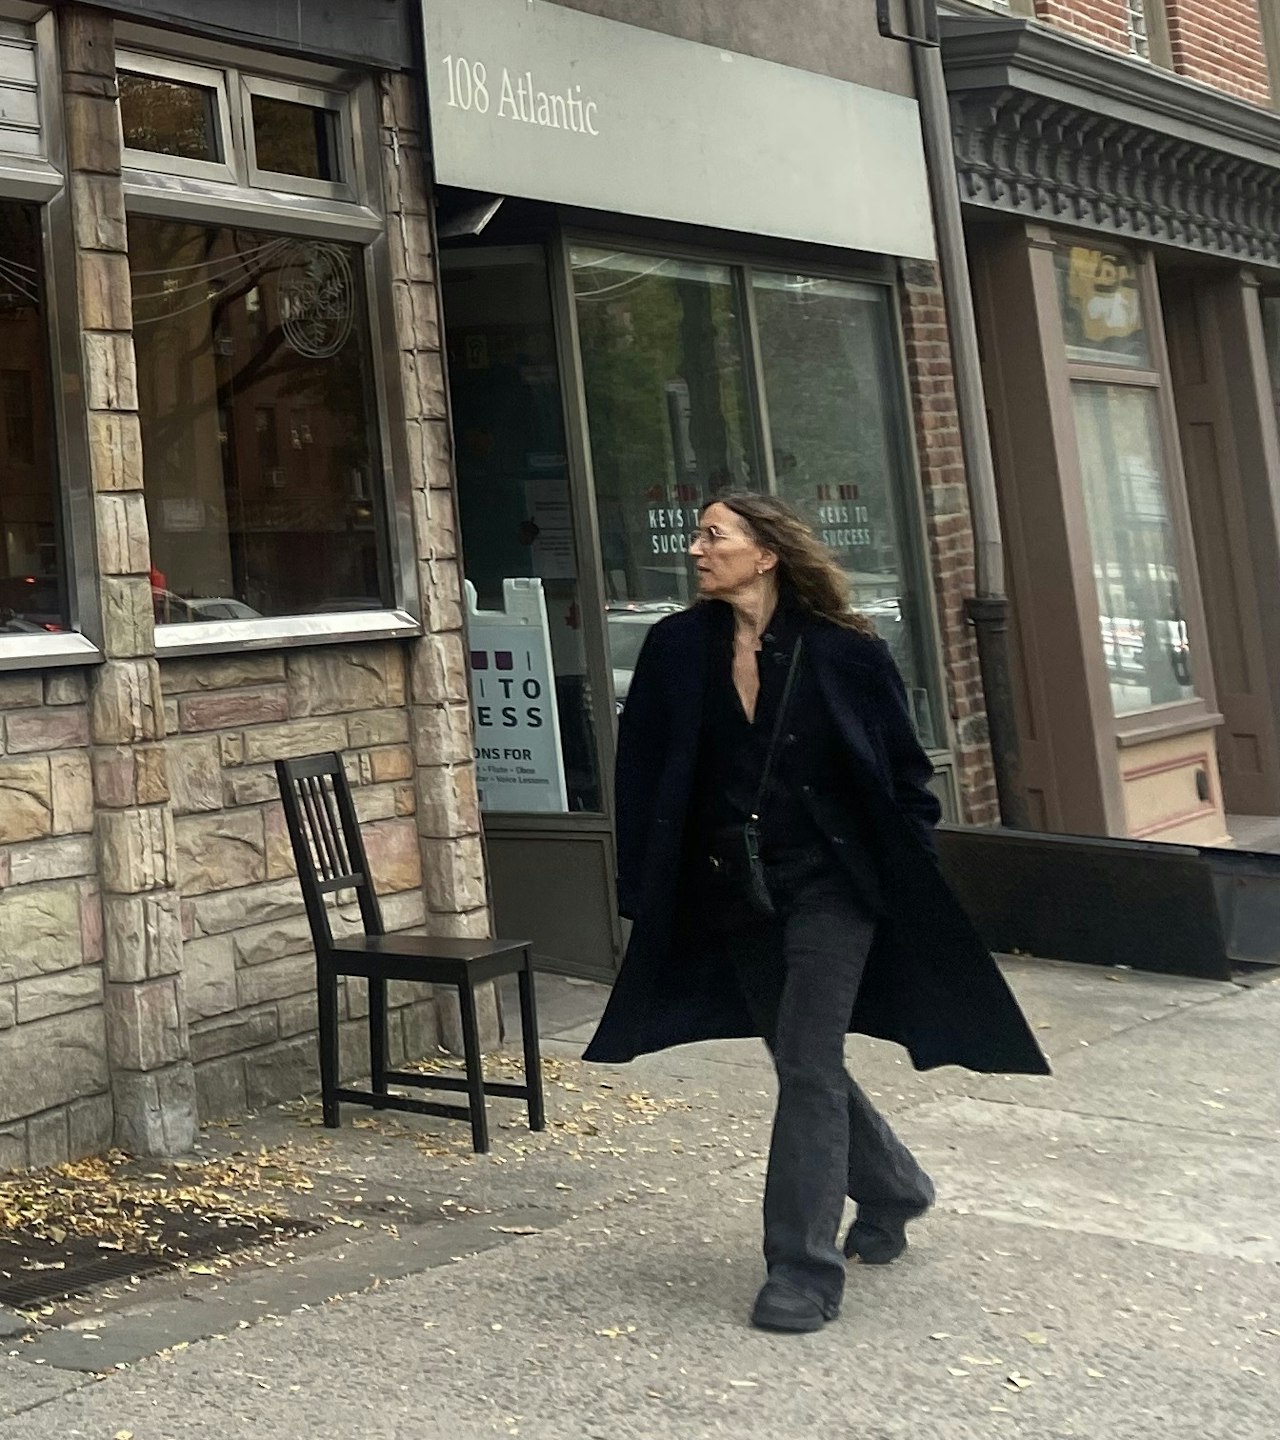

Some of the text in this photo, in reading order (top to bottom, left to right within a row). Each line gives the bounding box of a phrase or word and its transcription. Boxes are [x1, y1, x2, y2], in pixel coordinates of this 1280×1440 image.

[442, 54, 600, 136] 108 Atlantic
[648, 508, 684, 529] KEYS
[819, 506, 869, 524] KEYS TO
[651, 533, 688, 555] SUCC
[821, 528, 871, 546] SUCCESS
[498, 678, 542, 700] TO
[477, 706, 543, 728] ESS
[504, 748, 533, 761] FOR
